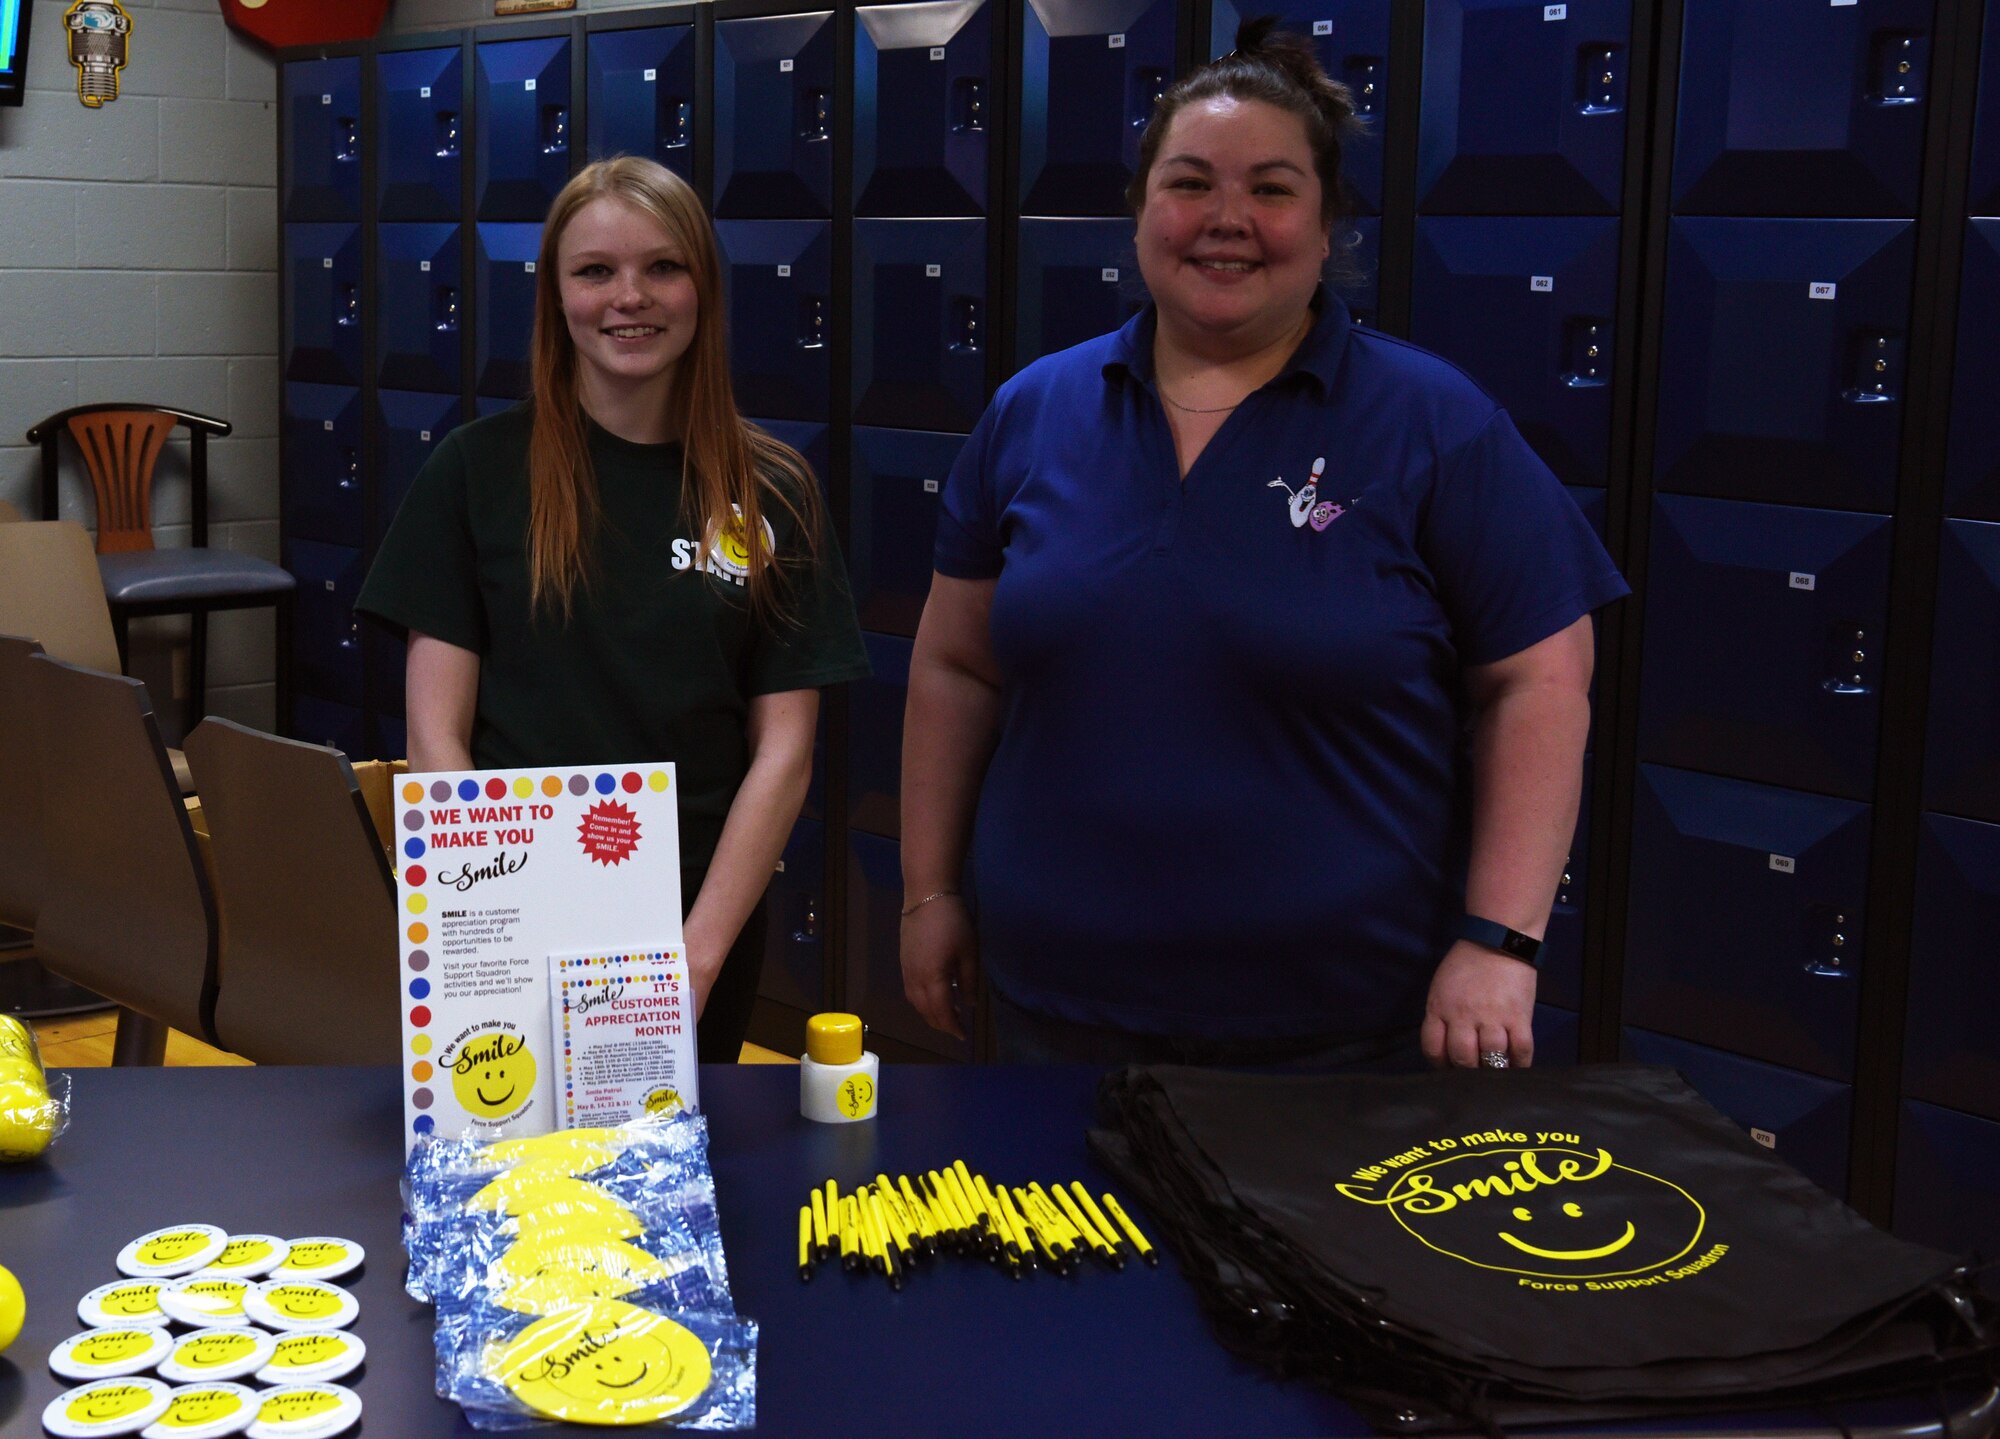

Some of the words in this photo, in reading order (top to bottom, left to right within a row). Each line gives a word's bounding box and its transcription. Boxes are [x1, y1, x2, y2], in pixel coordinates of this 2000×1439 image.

[430, 809, 461, 825] WE
[467, 806, 523, 823] WANT
[529, 804, 554, 820] TO
[592, 814, 631, 826] Remember!
[590, 823, 609, 832] Come
[431, 831, 488, 849] MAKE
[494, 828, 534, 845] YOU
[596, 843, 619, 852] SMILE.
[1775, 858, 1789, 867] 069
[438, 851, 528, 892] Smile
[442, 910, 467, 918] SMILE
[486, 908, 520, 916] customer
[442, 919, 488, 928] appreciation
[490, 918, 520, 926] program
[460, 927, 494, 936] hundreds
[496, 926, 504, 934] of
[442, 936, 492, 946] opportunities
[443, 946, 479, 955] rewarded.
[462, 962, 478, 970] your
[480, 960, 508, 968] favorite
[510, 958, 530, 966] Force
[444, 971, 473, 980] Support
[476, 968, 511, 978] Squadron
[444, 980, 477, 988] activities
[654, 982, 679, 993] IT'S
[444, 991, 458, 1000] you
[474, 986, 522, 996] appreciation!
[565, 985, 624, 1014] Smile
[611, 996, 680, 1010] CUSTOMER
[585, 1010, 680, 1027] APPRECIATION
[444, 1042, 456, 1054] We
[455, 1028, 471, 1044] want
[472, 1024, 480, 1032] to
[481, 1019, 501, 1029] make
[502, 1022, 516, 1030] you
[635, 1025, 681, 1037] MONTH
[438, 1034, 526, 1075] Smile
[638, 1089, 678, 1109] Smile
[845, 1081, 860, 1116] Smile
[470, 1118, 487, 1127] Force
[488, 1118, 511, 1127] Support
[511, 1100, 534, 1121] Squadron
[1352, 1165, 1389, 1182] We
[1380, 1146, 1432, 1170] want
[1428, 1137, 1458, 1151] to
[1461, 1129, 1528, 1147] make
[1536, 1132, 1580, 1144] you
[1334, 1147, 1613, 1214] Smile
[1518, 1278, 1580, 1292] Force
[1584, 1274, 1670, 1291] Support
[1664, 1243, 1730, 1280] Squadron
